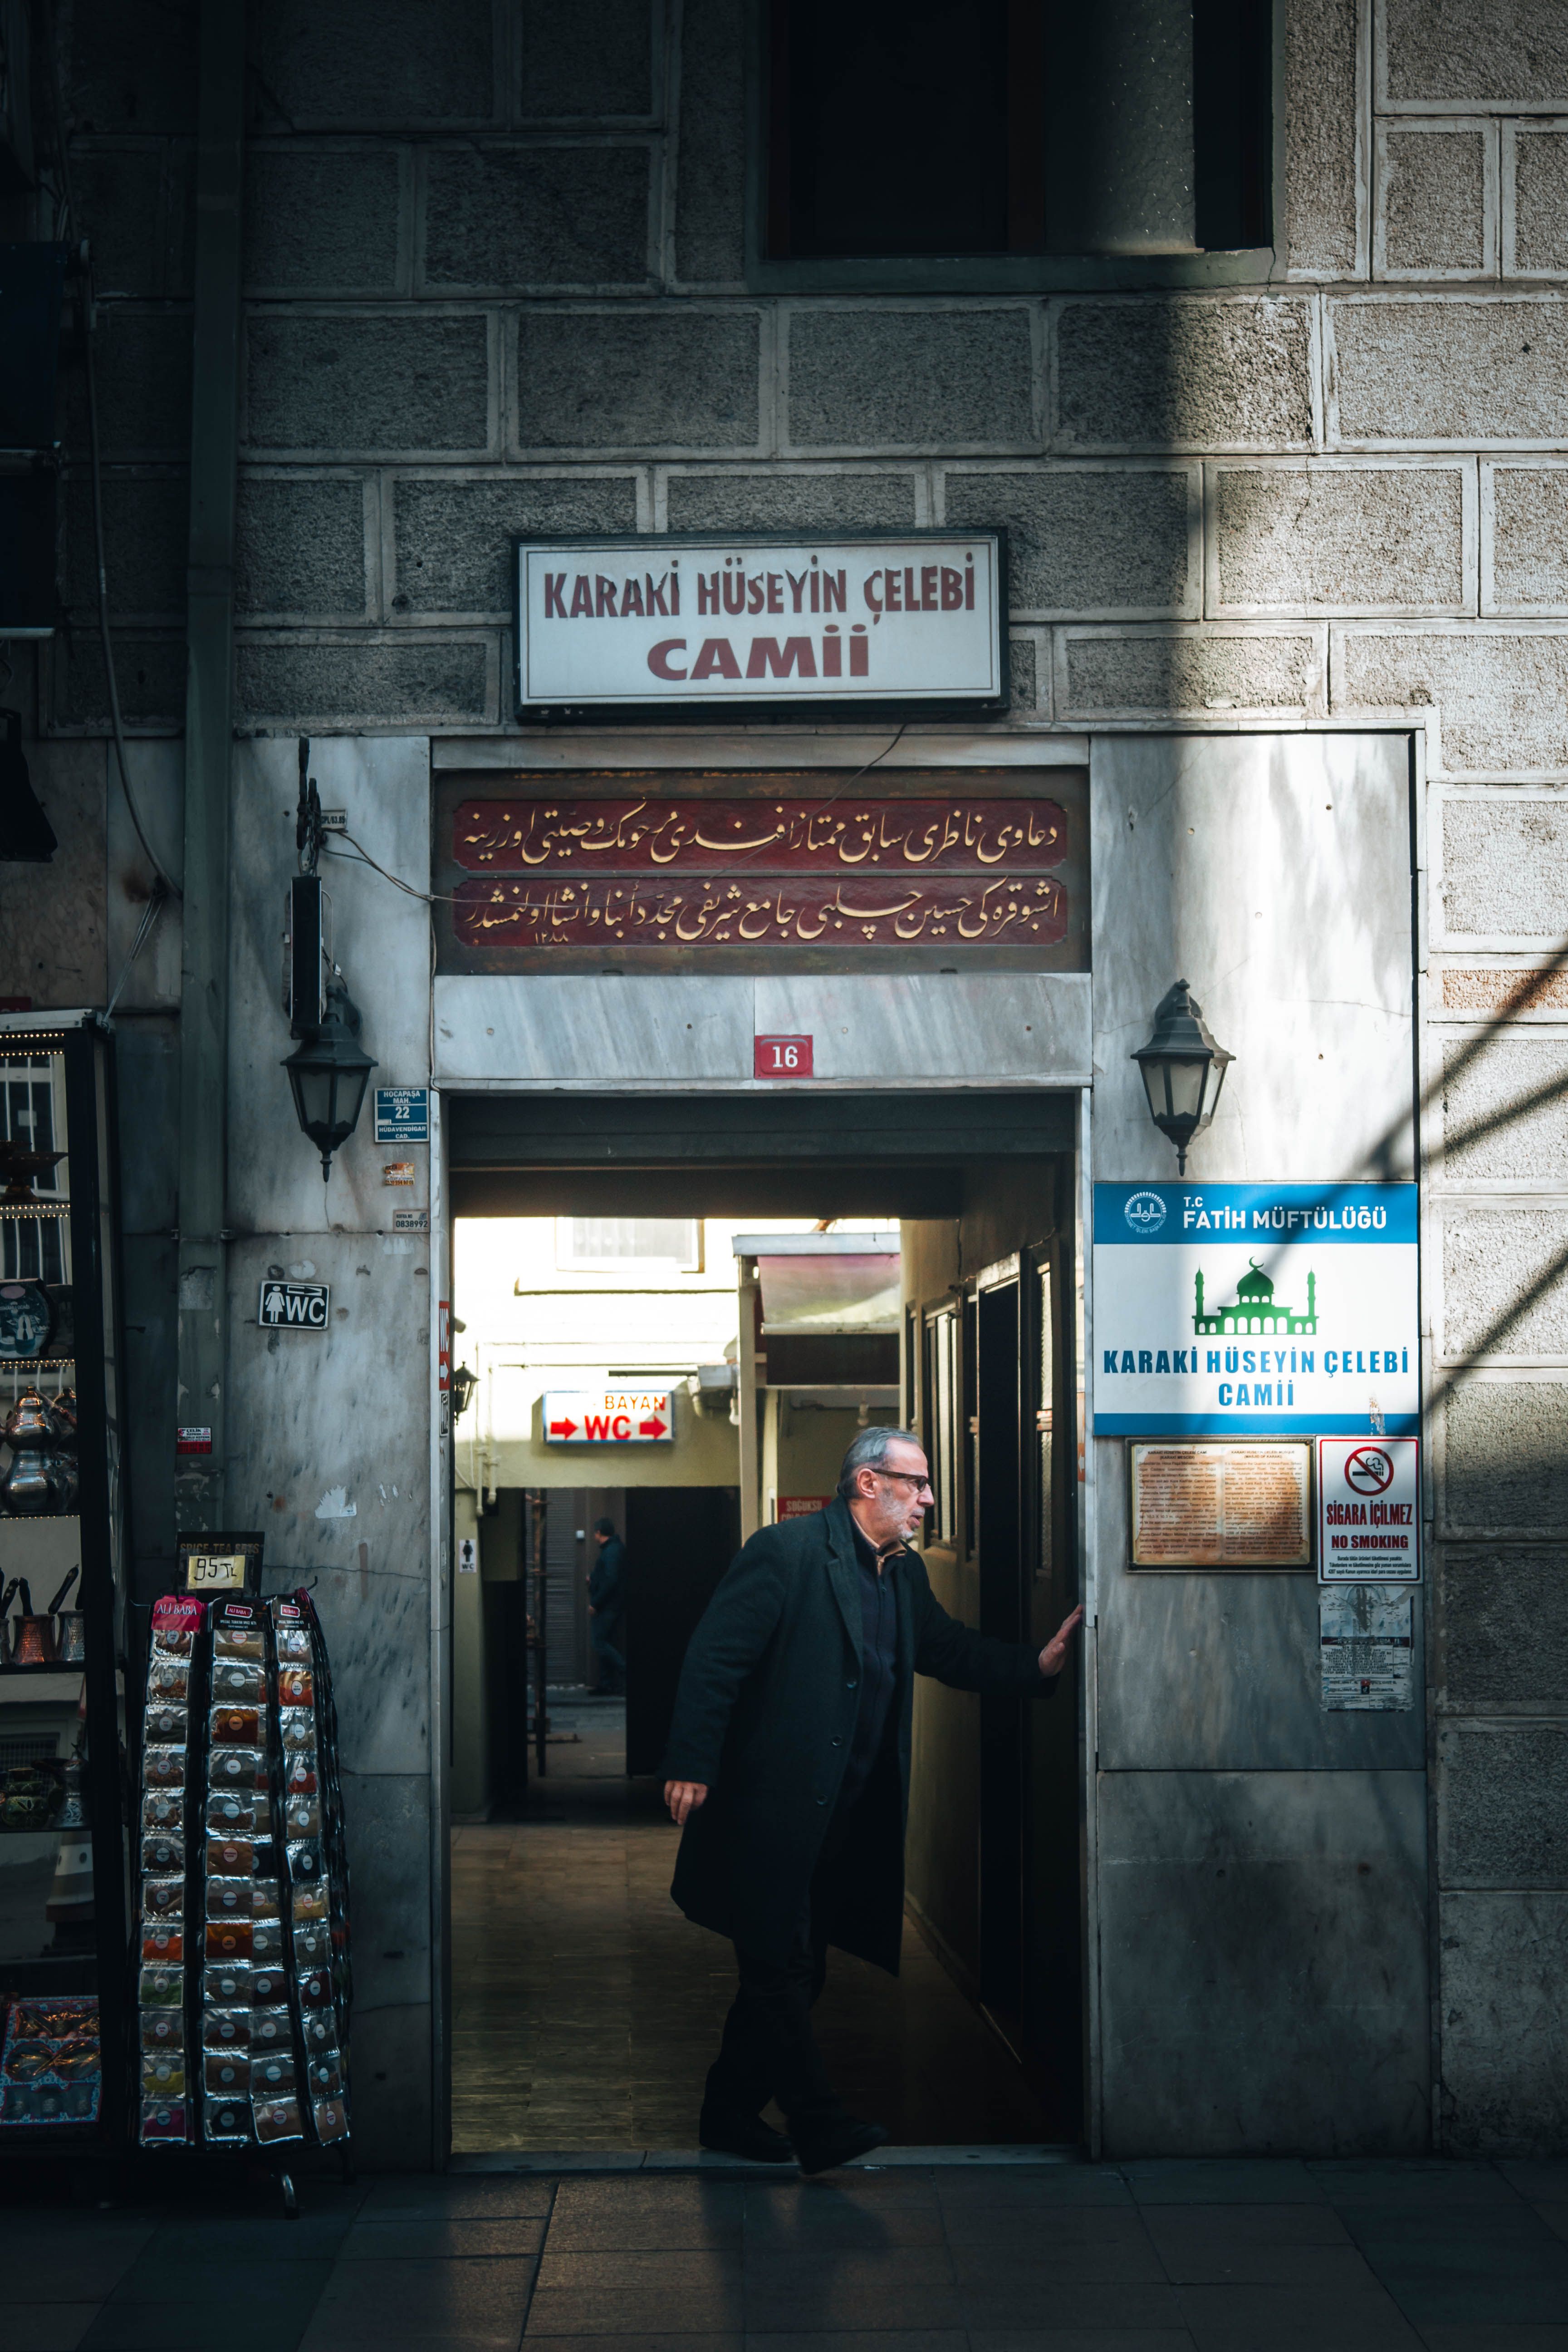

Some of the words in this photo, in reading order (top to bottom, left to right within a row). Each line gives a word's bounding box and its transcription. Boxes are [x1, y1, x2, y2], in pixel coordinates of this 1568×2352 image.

[545, 560, 680, 618] KARAKİ
[698, 554, 847, 616] HÜSEYİN
[864, 552, 975, 626] ÇELEBİ
[647, 624, 869, 681] CAMİİ
[773, 1045, 798, 1068] 16
[384, 1090, 420, 1098] HOCAPAŞA
[395, 1106, 410, 1119] 22
[1183, 1196, 1203, 1208] T.C
[1184, 1206, 1246, 1229] FATİH
[1253, 1205, 1387, 1229] MÜFTÜLÜĞÜ
[286, 1295, 325, 1323] WC
[1104, 1346, 1198, 1374] KARAKİ
[1207, 1346, 1315, 1374] HÜSEYİN
[1324, 1347, 1408, 1378] ÇELEBİ
[605, 1396, 666, 1412] BAYAN
[1218, 1380, 1294, 1406] CAMİİ
[584, 1415, 632, 1441] WC
[1327, 1499, 1367, 1525] SİGARA
[1370, 1499, 1412, 1529] İÇİLMEZ
[1331, 1535, 1348, 1548] NO
[1351, 1535, 1409, 1548] SMOKING
[194, 1557, 217, 1581] 95
[220, 1563, 237, 1578] TL
[174, 1604, 196, 1615] BABA
